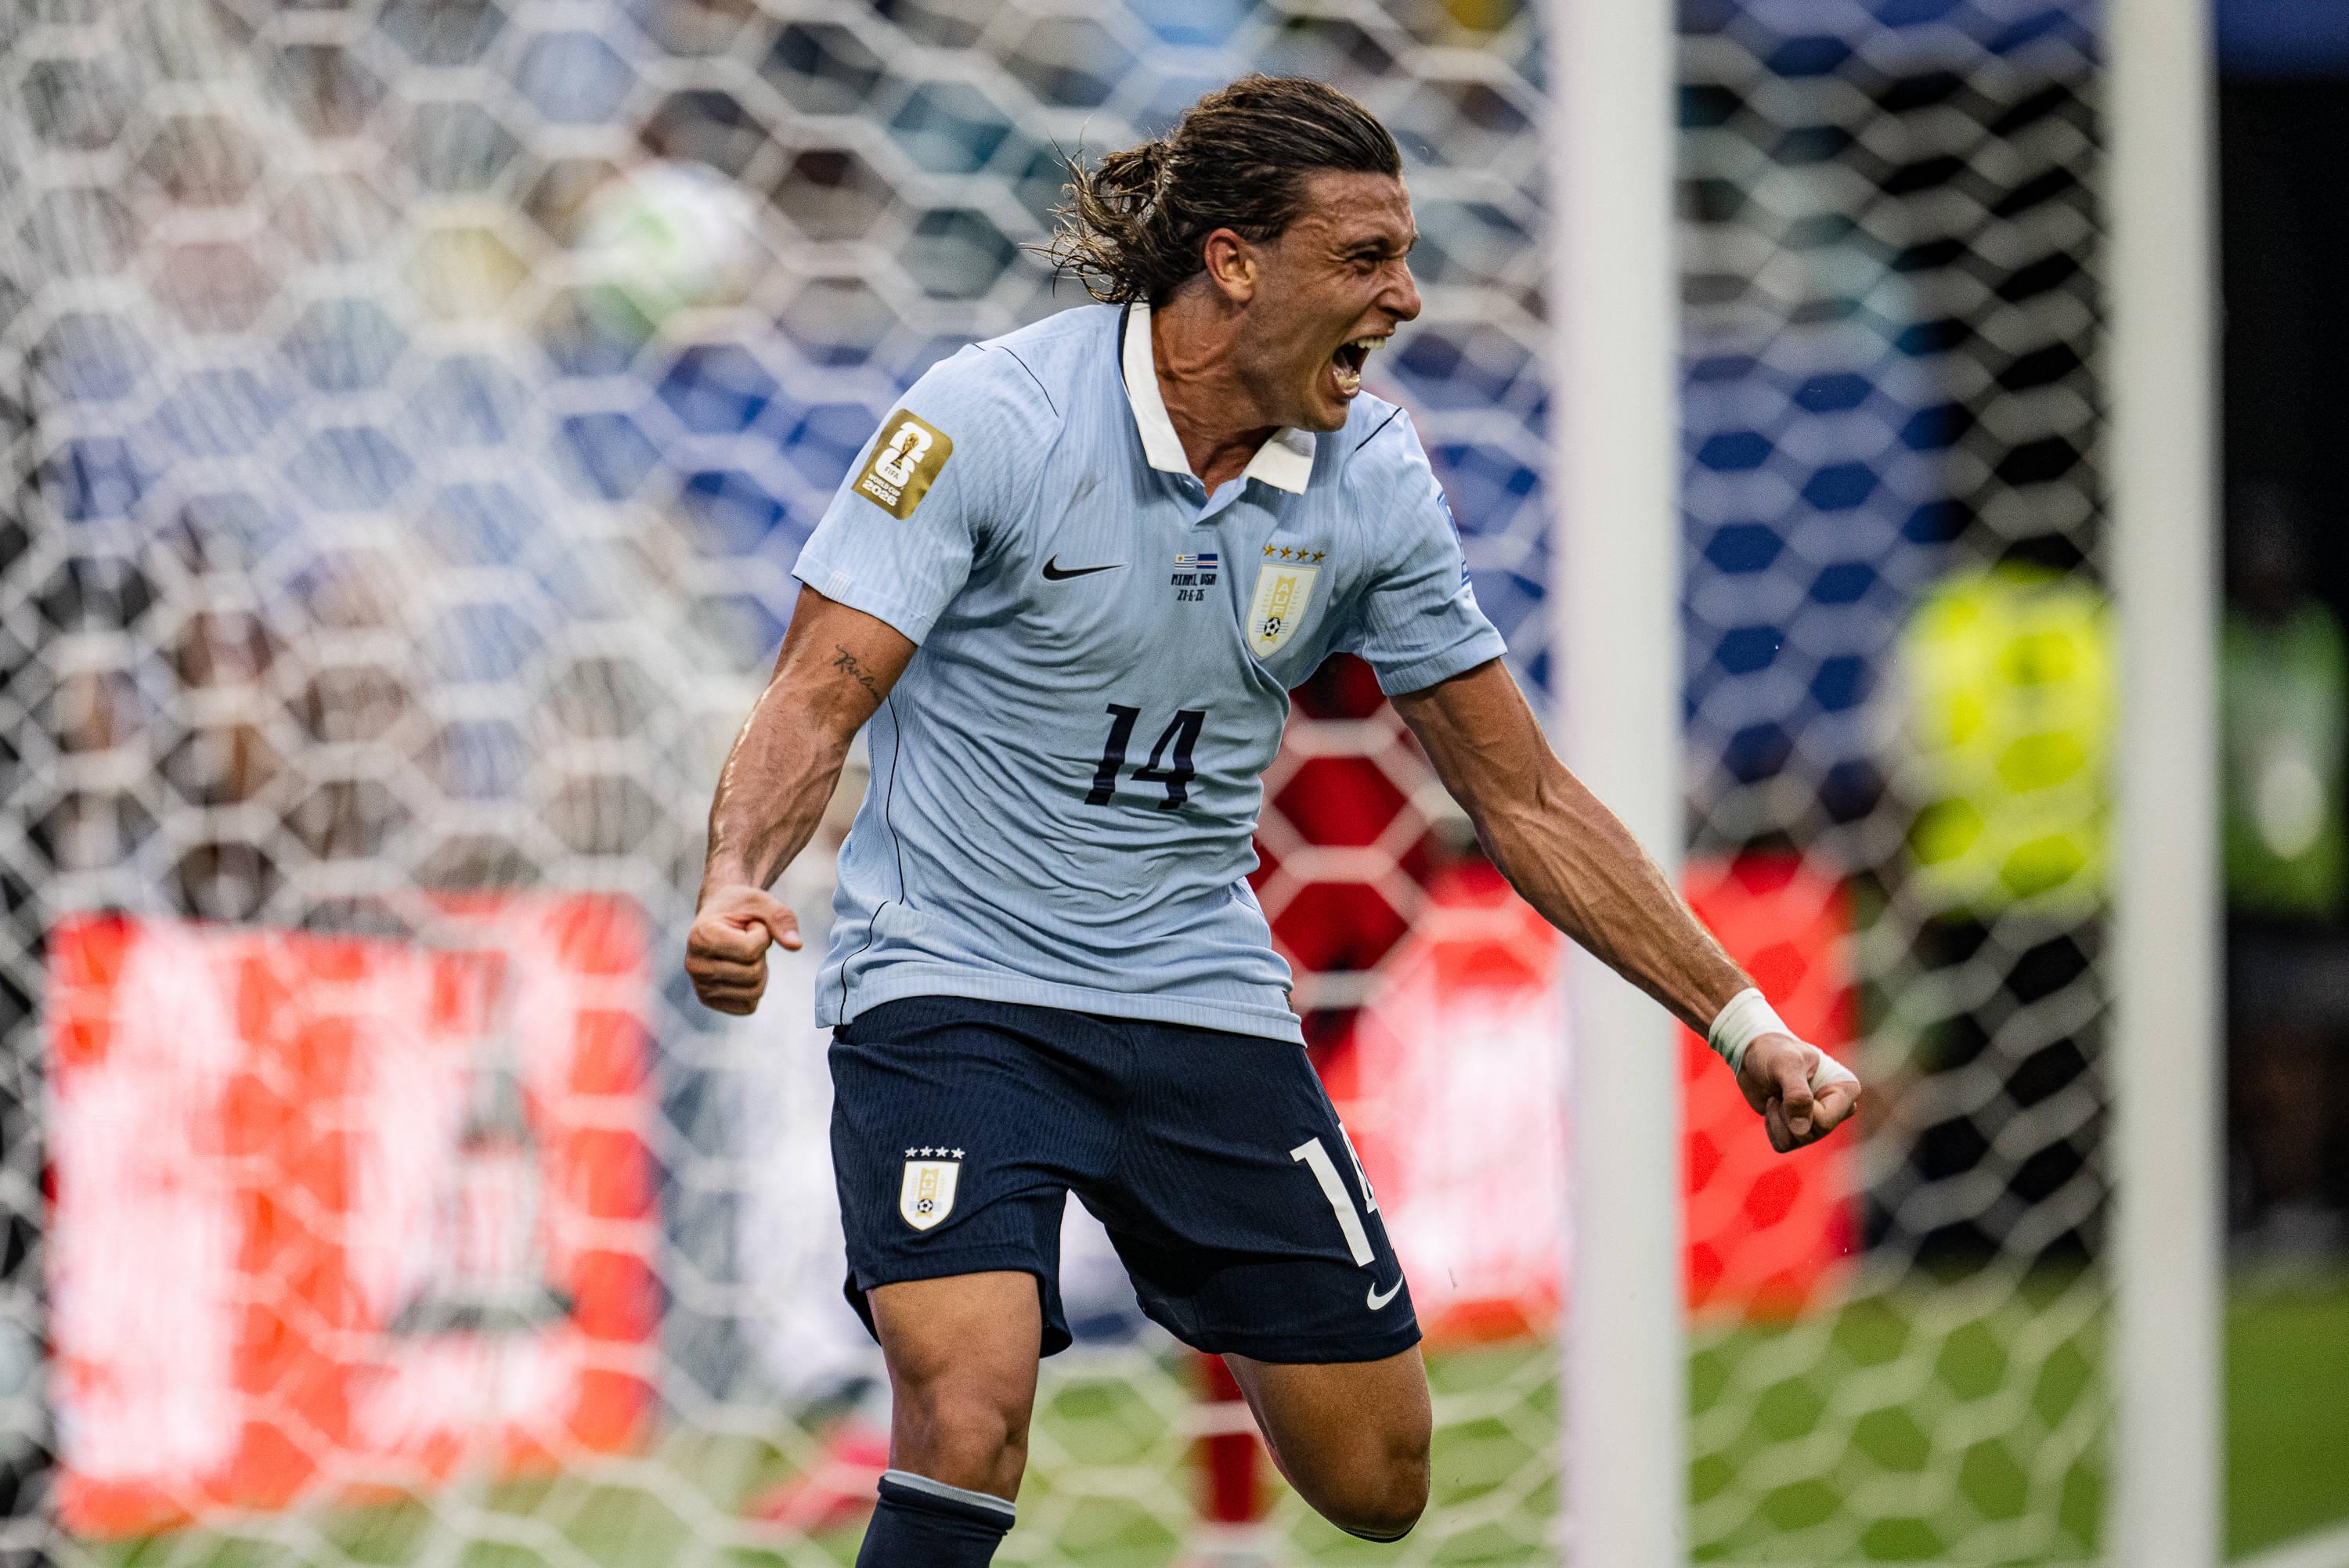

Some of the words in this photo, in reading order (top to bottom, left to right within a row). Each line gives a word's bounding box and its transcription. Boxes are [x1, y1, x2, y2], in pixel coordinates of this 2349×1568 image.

[884, 466, 899, 479] FIFA
[868, 473, 889, 490] WORLD
[1200, 573, 1217, 586] USA
[1084, 703, 1206, 809] 14
